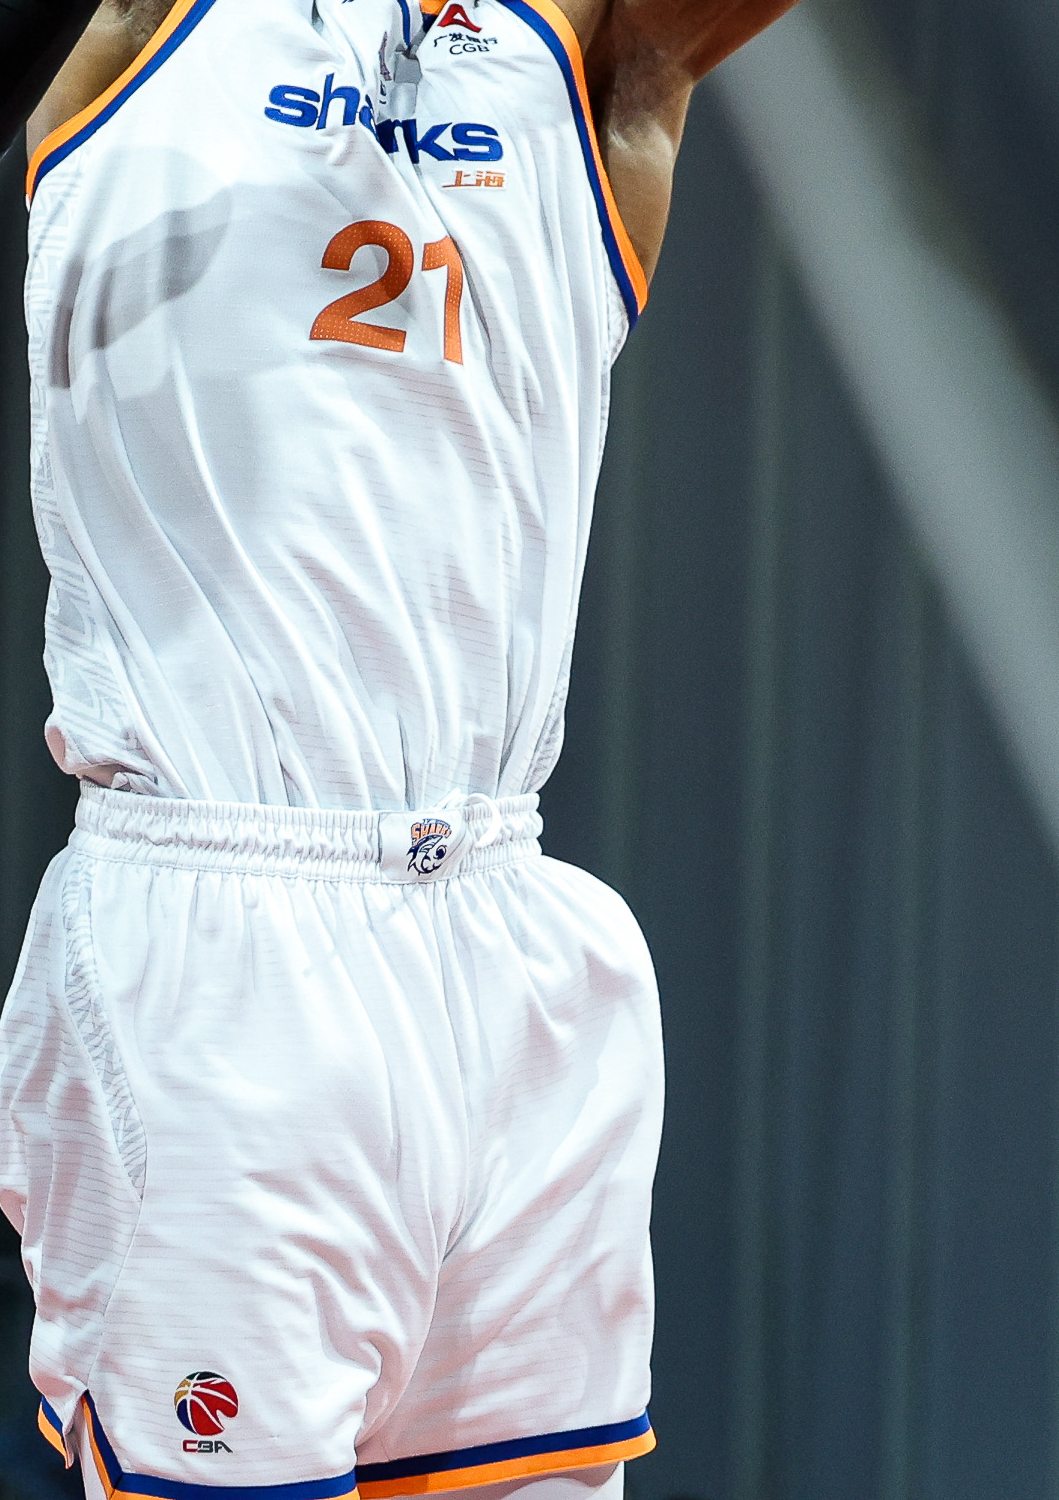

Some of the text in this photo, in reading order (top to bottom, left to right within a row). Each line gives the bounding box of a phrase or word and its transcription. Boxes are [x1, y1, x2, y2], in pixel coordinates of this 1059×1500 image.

[442, 170, 506, 189] 上海
[309, 219, 464, 366] 21
[182, 1439, 234, 1454] CBA
